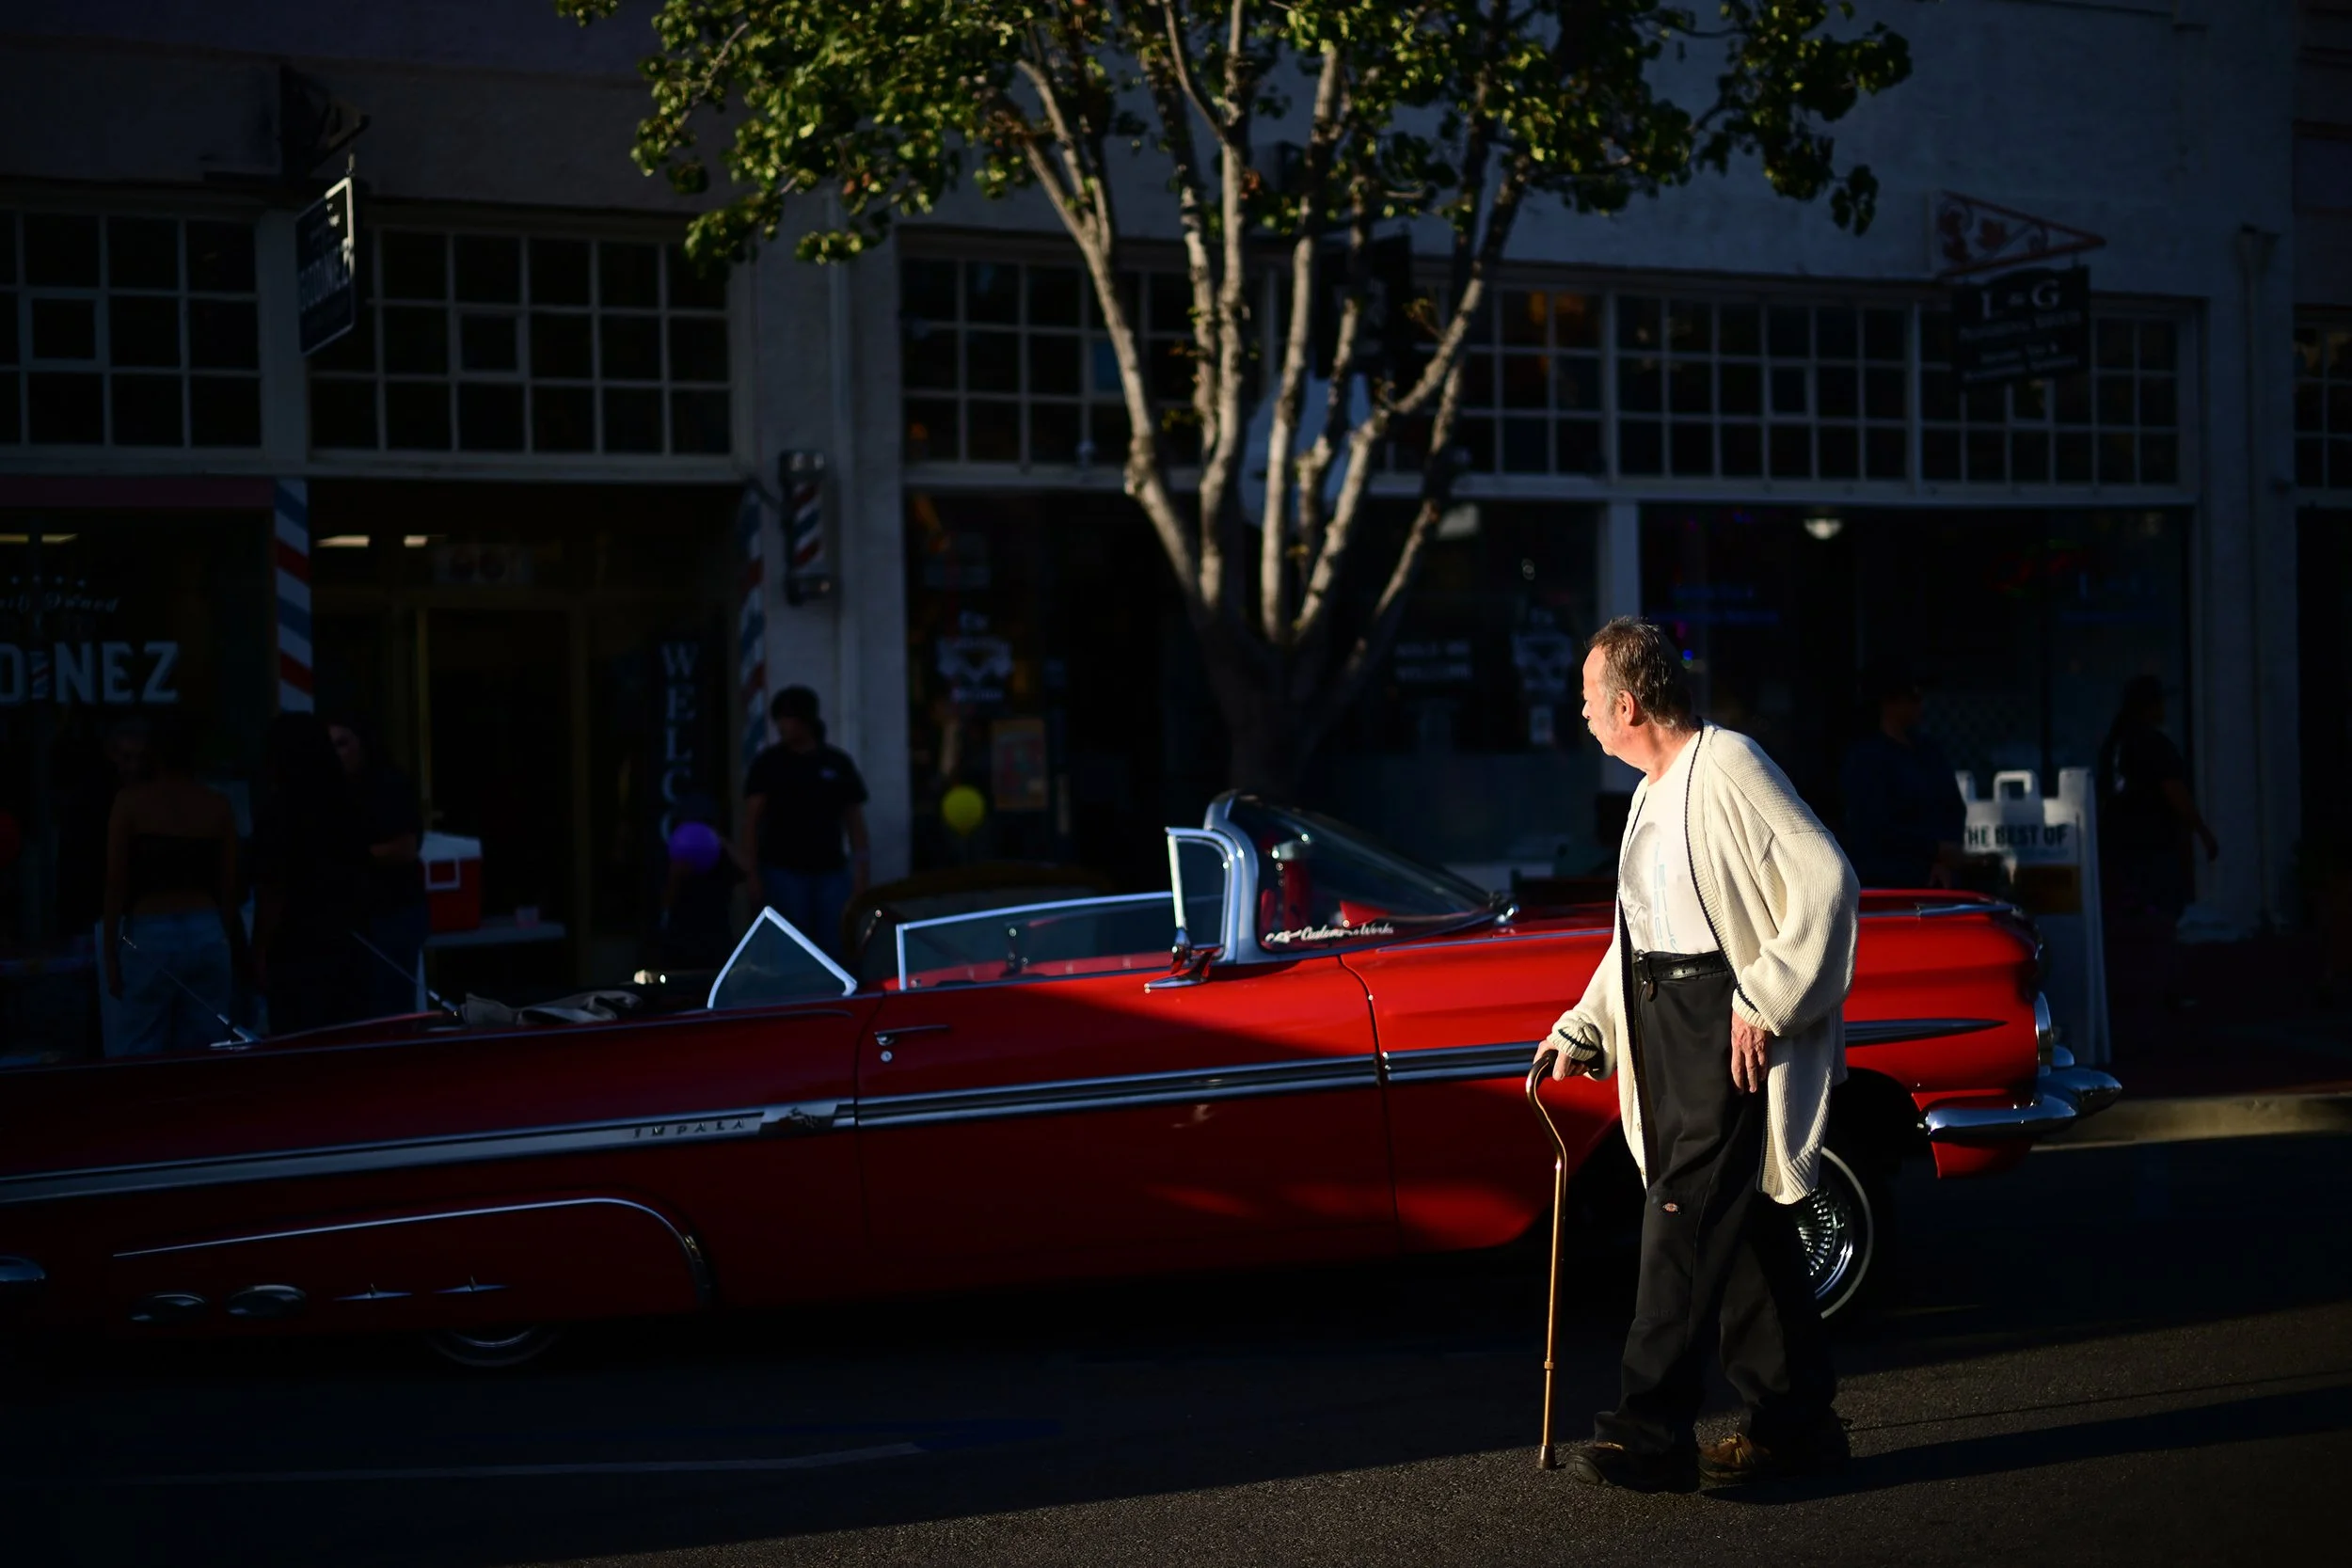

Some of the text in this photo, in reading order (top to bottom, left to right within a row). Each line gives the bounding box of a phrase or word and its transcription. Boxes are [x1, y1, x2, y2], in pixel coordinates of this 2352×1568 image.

[1963, 825, 2068, 846] HE BEST OF
[633, 1118, 745, 1139] IMPALA
